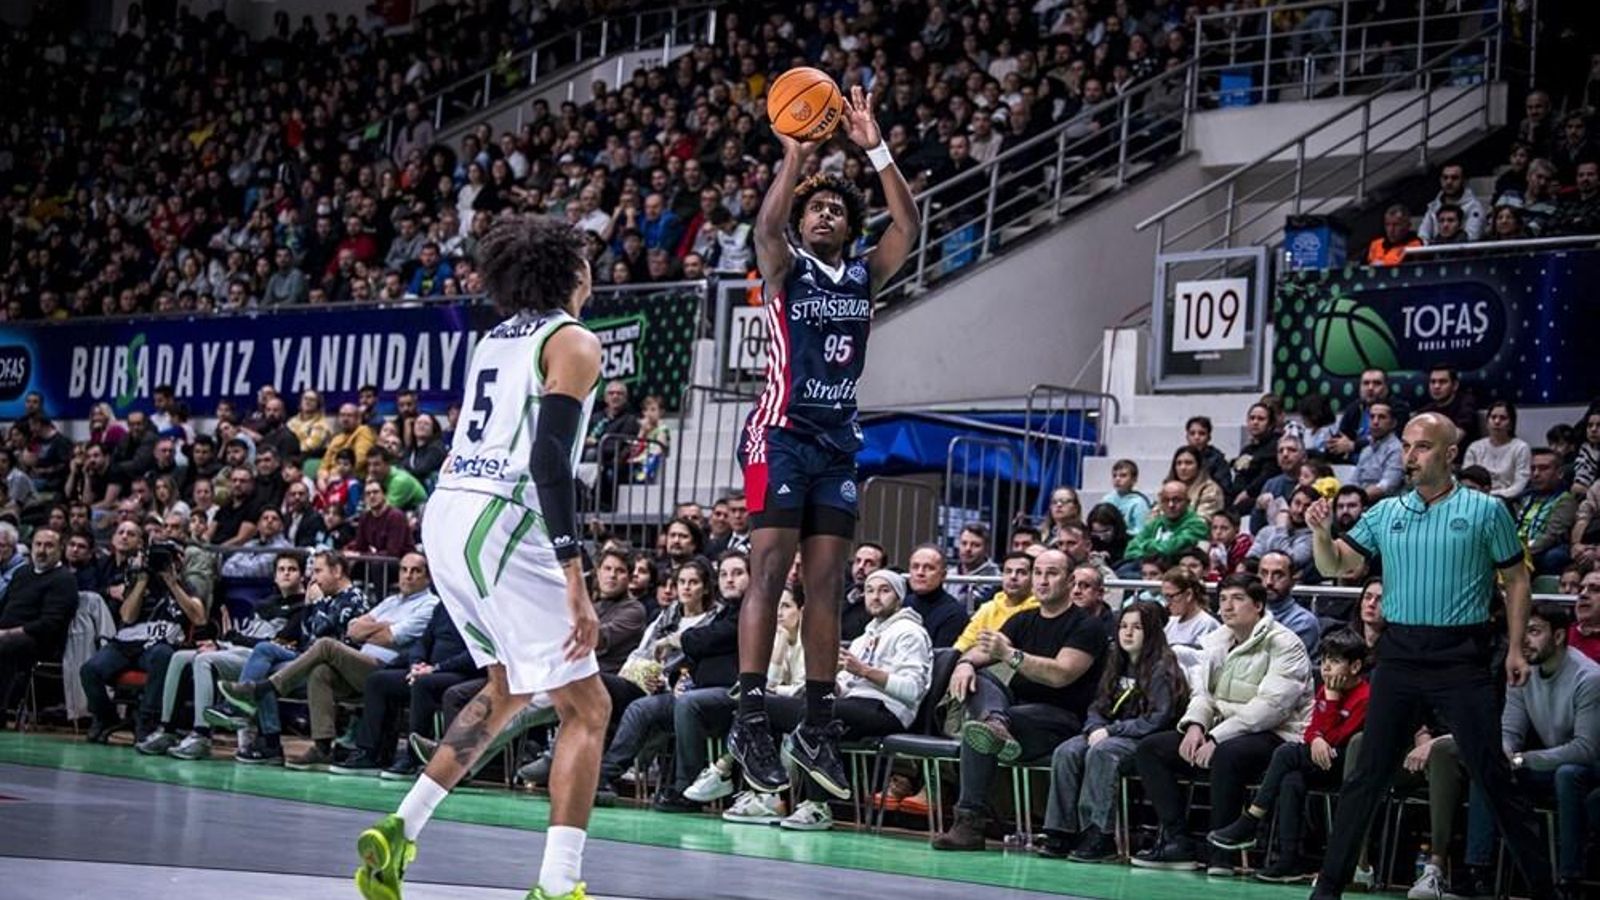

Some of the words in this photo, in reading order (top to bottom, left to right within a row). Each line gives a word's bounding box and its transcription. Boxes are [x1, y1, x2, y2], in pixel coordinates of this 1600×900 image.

[791, 297, 870, 321] STRASBOUR
[1182, 288, 1239, 341] 109
[1401, 300, 1489, 344] TOFAŞ
[271, 330, 479, 395] YANINDAYI
[823, 333, 854, 363] 95
[466, 367, 499, 443] 5
